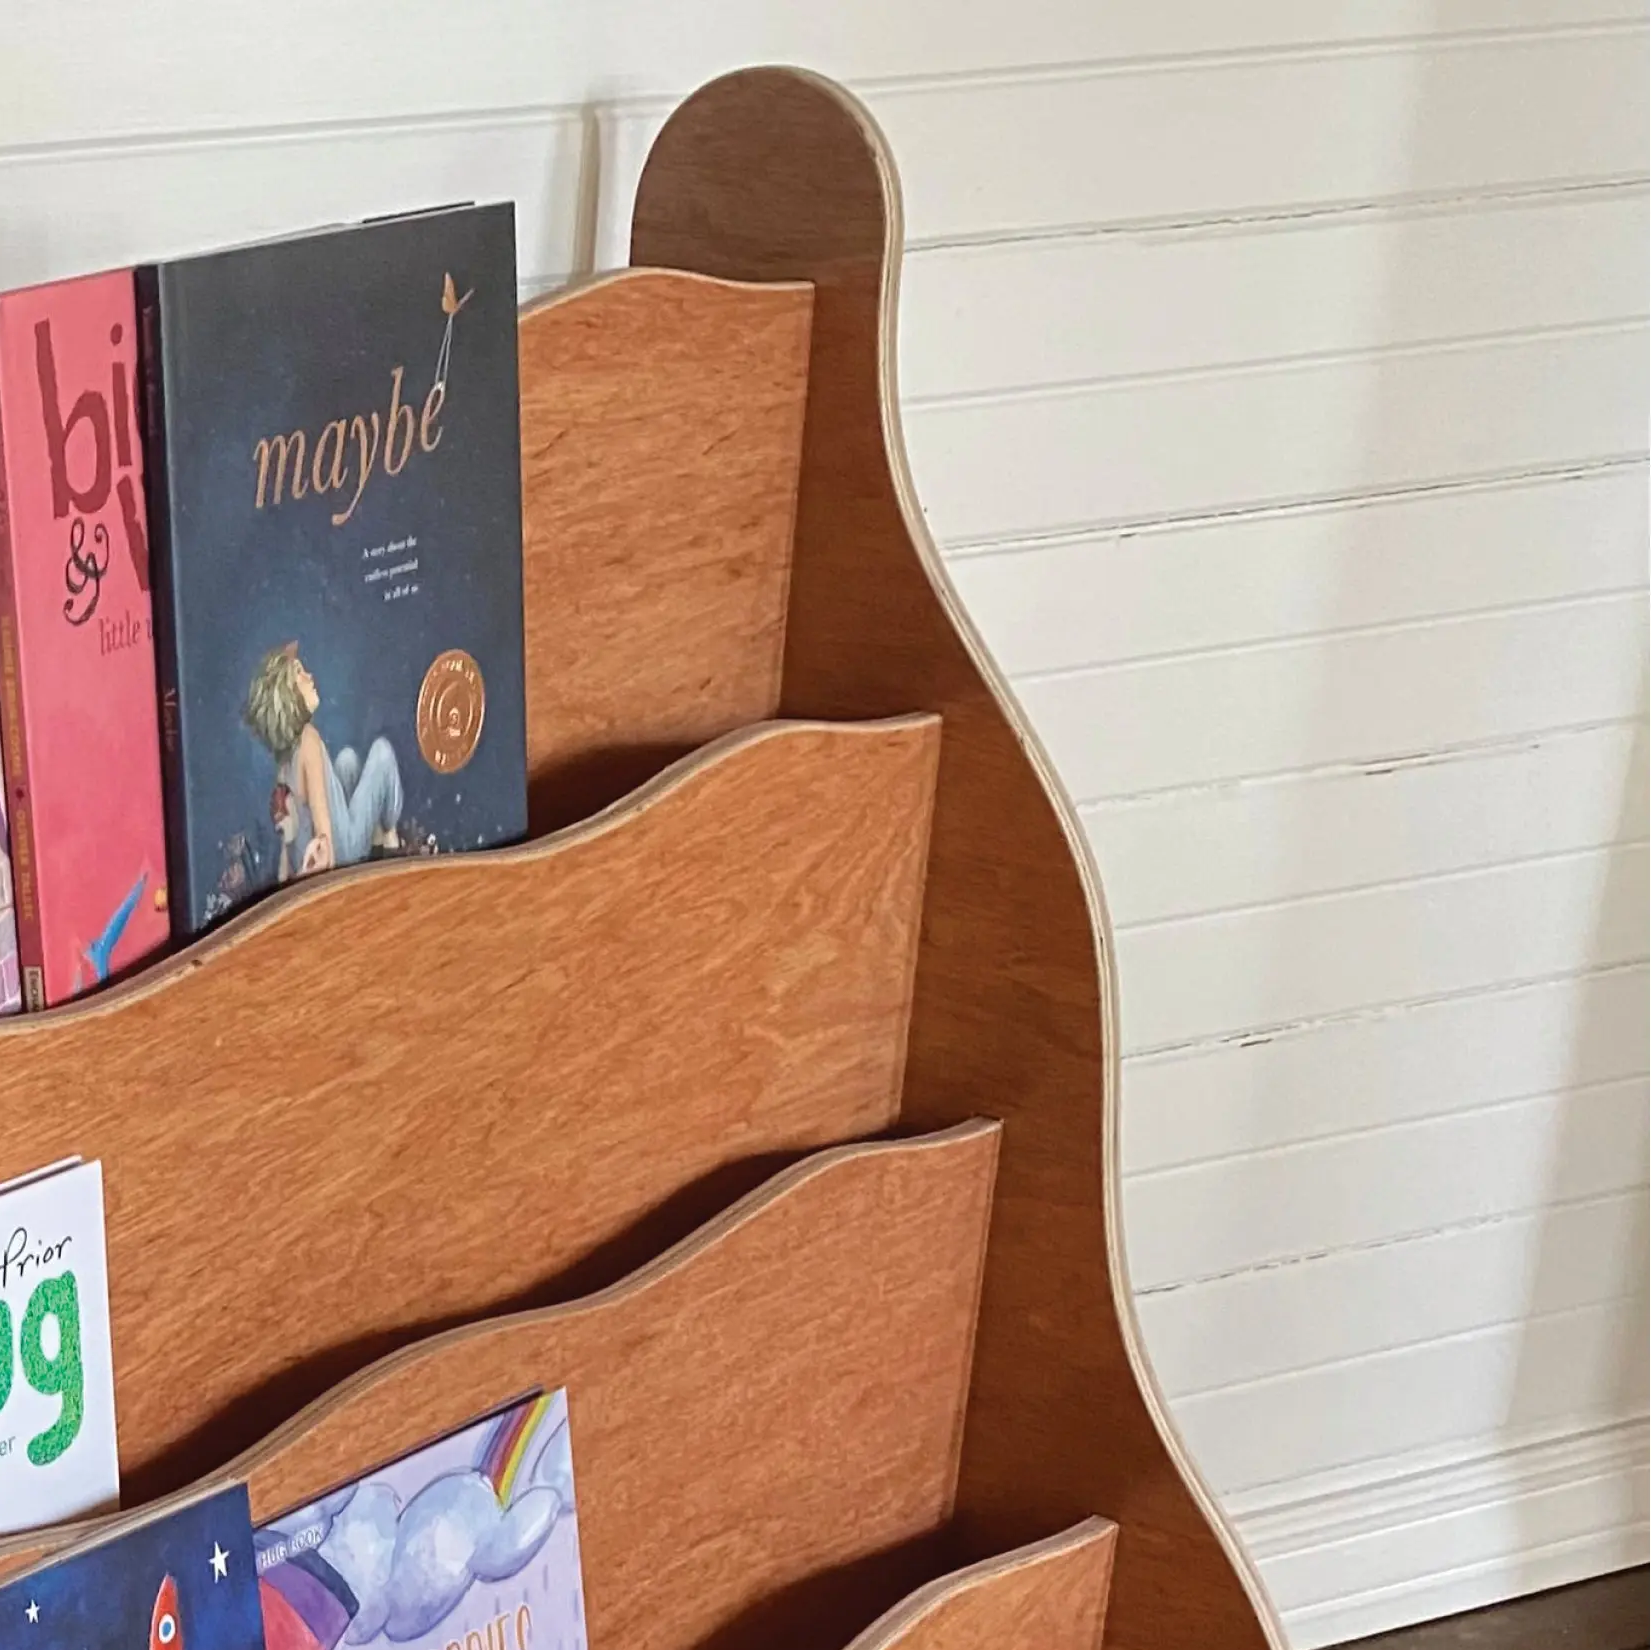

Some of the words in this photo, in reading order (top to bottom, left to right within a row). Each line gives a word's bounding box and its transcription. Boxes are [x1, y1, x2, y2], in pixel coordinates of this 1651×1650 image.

[253, 366, 446, 526] maybe
[63, 517, 110, 627] &
[99, 619, 140, 657] little
